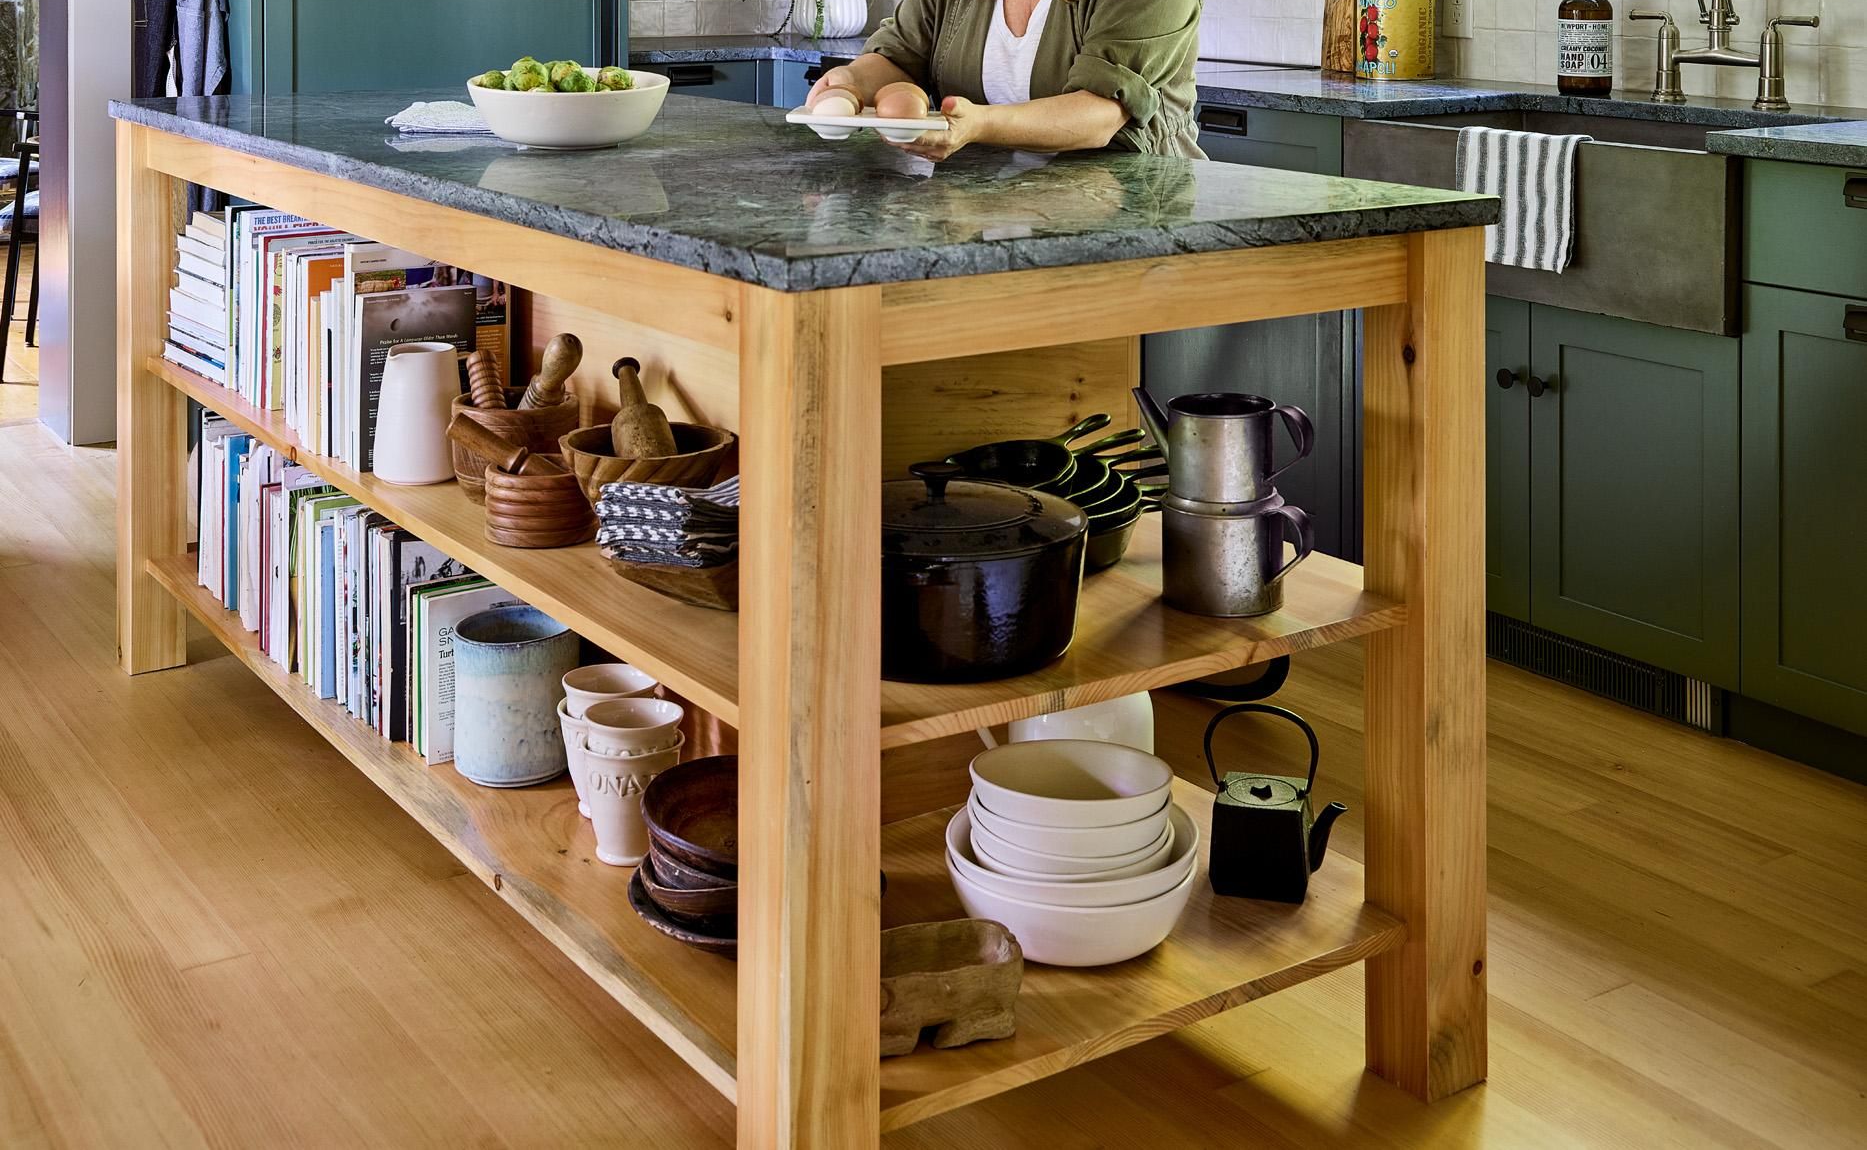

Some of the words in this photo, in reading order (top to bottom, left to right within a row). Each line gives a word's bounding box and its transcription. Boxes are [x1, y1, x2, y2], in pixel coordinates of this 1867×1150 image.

[1418, 7, 1427, 64] ORGANIC
[1560, 53, 1584, 61] HAND
[1590, 53, 1608, 69] 04
[1560, 61, 1584, 69] SOAP
[254, 217, 266, 225] THE
[266, 215, 282, 225] BEST
